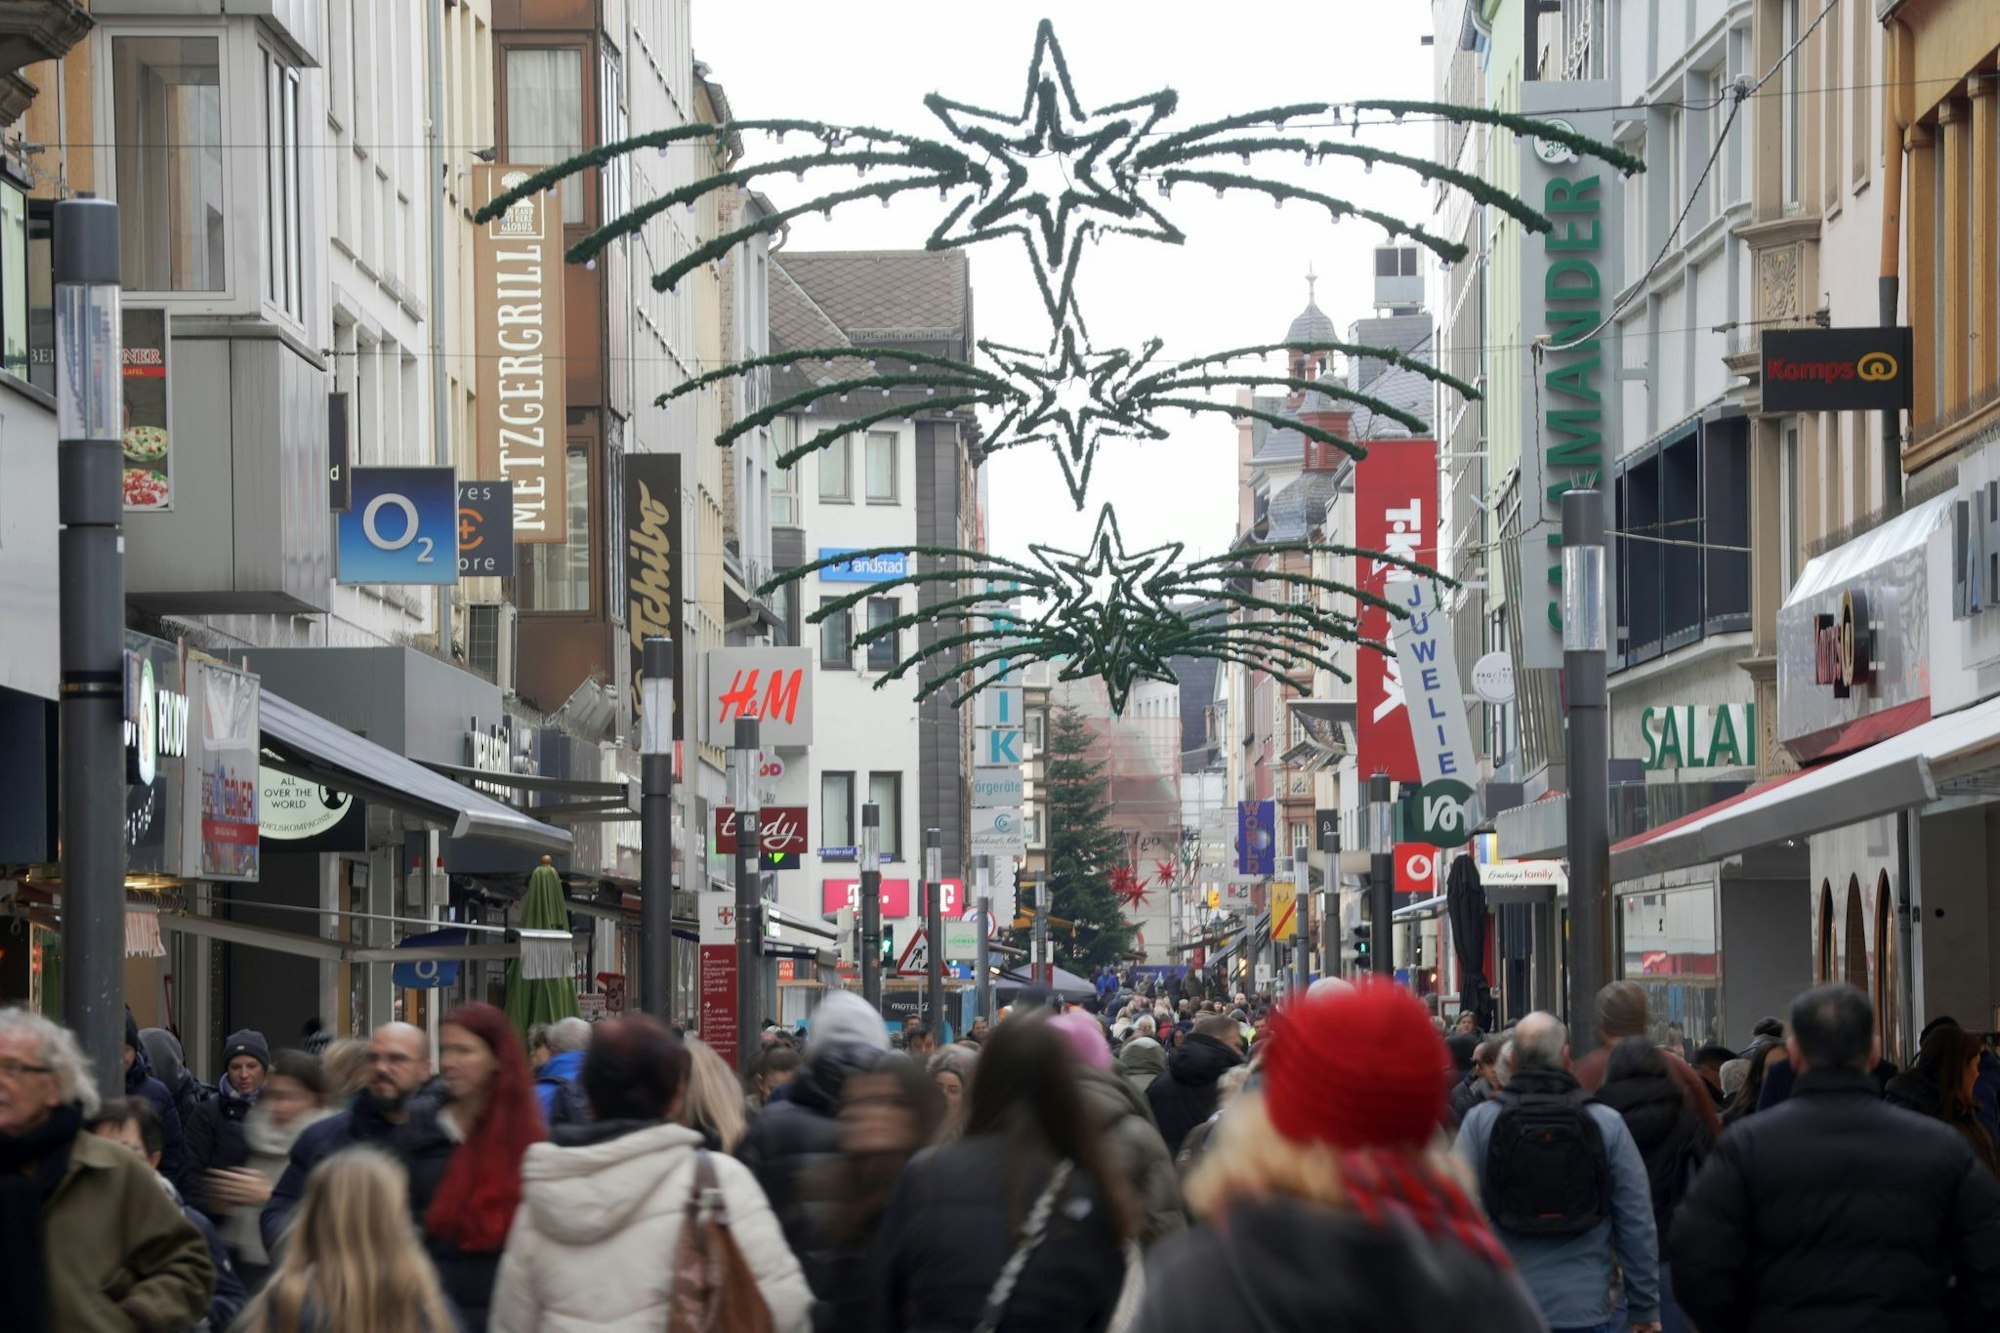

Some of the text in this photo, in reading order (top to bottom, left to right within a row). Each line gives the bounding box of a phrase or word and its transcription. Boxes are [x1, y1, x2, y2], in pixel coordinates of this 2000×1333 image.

[122, 348, 162, 364] NER
[496, 244, 546, 532] METZGERGRILL
[629, 478, 671, 652] Tchibo
[851, 558, 904, 574] andstad
[1407, 583, 1458, 775] JUWELIE
[718, 668, 803, 726] H&M
[158, 689, 189, 758] FOODY
[1641, 702, 1756, 771] SALA
[264, 788, 312, 797] OVER THE
[280, 777, 296, 786] ALL
[975, 781, 1022, 796] örgeräte
[271, 800, 307, 809] WORLD
[258, 811, 333, 833] NDELSKOMPAGNIE
[721, 812, 804, 850] tdy
[1524, 869, 1553, 880] family
